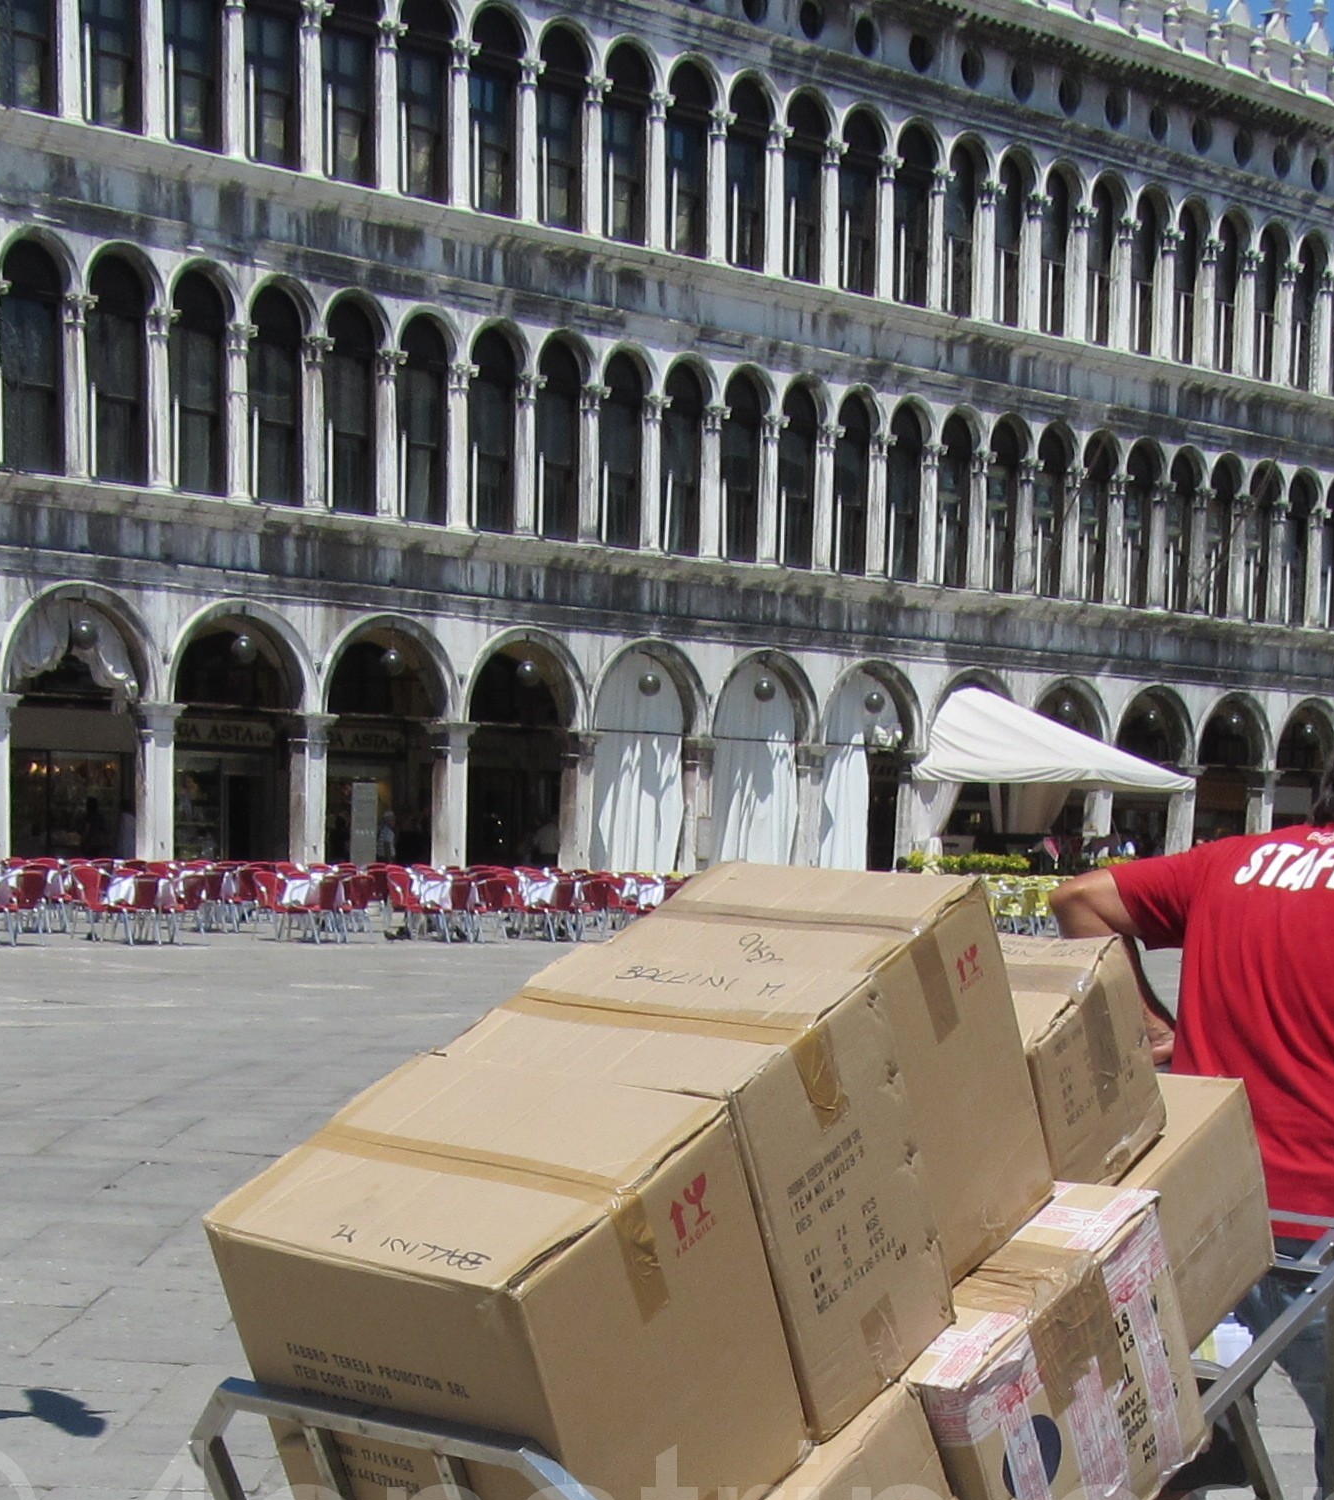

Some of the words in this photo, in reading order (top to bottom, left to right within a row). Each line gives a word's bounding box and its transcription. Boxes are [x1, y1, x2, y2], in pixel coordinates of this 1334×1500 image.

[861, 1196, 877, 1217] PCS
[676, 1214, 718, 1259] FRAGILE
[868, 1227, 886, 1249] KGS
[895, 1243, 908, 1262] CM
[285, 1341, 328, 1364] FABBRO
[332, 1353, 374, 1376] TERESA
[377, 1364, 443, 1393] PROMOTION
[447, 1381, 470, 1399] SRL
[1118, 1387, 1142, 1419] NAVY
[1131, 1399, 1148, 1422] PCS
